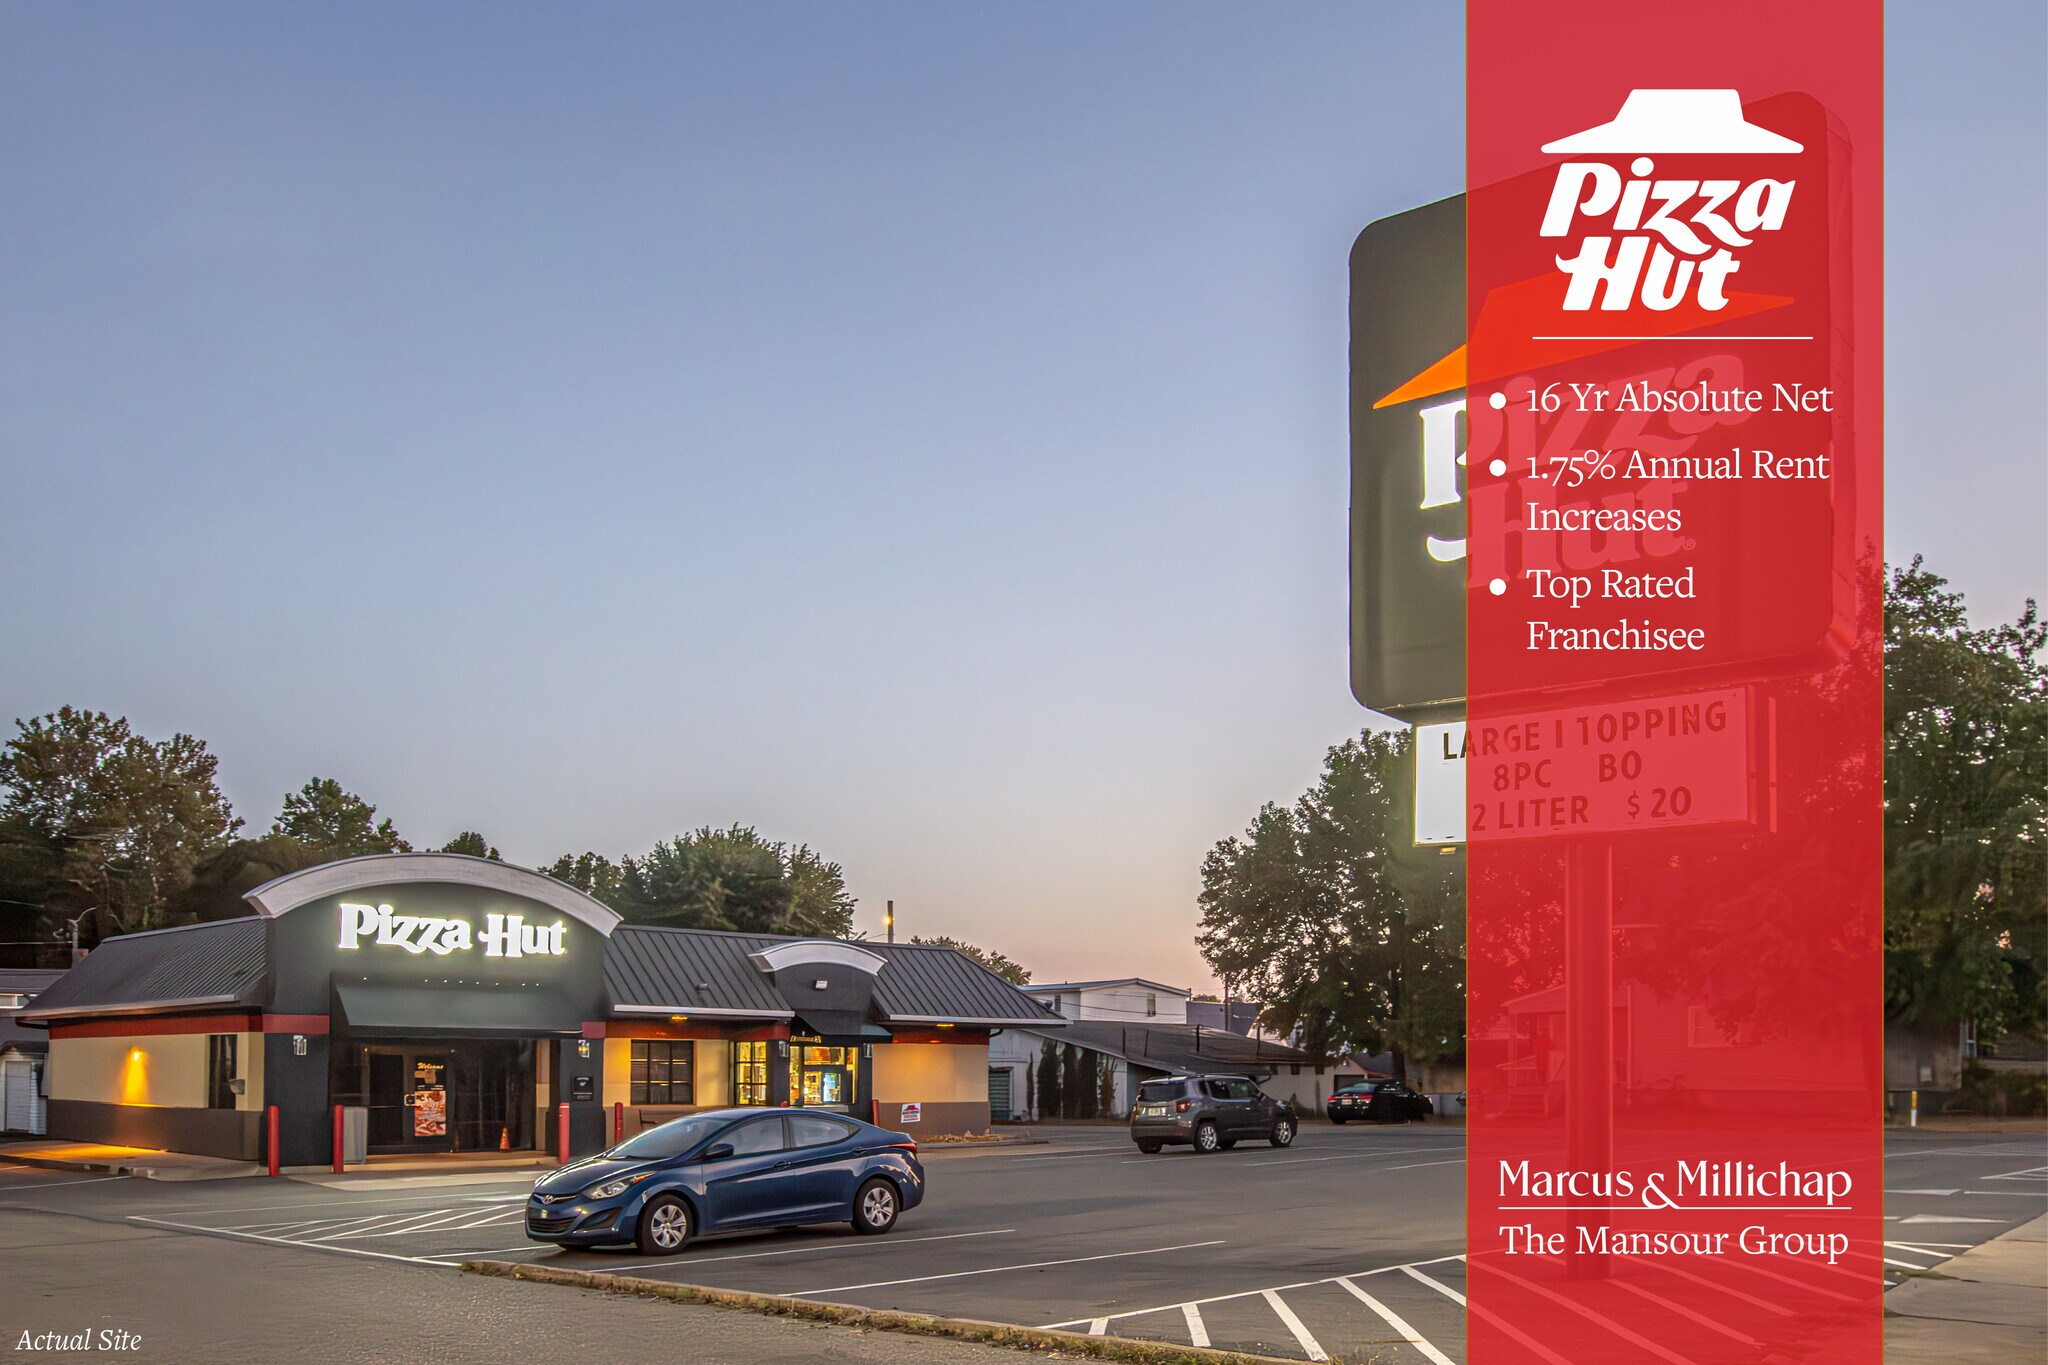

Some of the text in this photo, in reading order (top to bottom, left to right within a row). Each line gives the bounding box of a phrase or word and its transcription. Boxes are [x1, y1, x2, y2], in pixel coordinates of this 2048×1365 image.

[1443, 722, 1541, 760] LARGE
[1576, 700, 1727, 746] TOPPING
[1493, 759, 1552, 792] 8PC
[1471, 803, 1487, 832] 2
[1498, 795, 1589, 830] LITER
[338, 903, 567, 957] Pizza Hut
